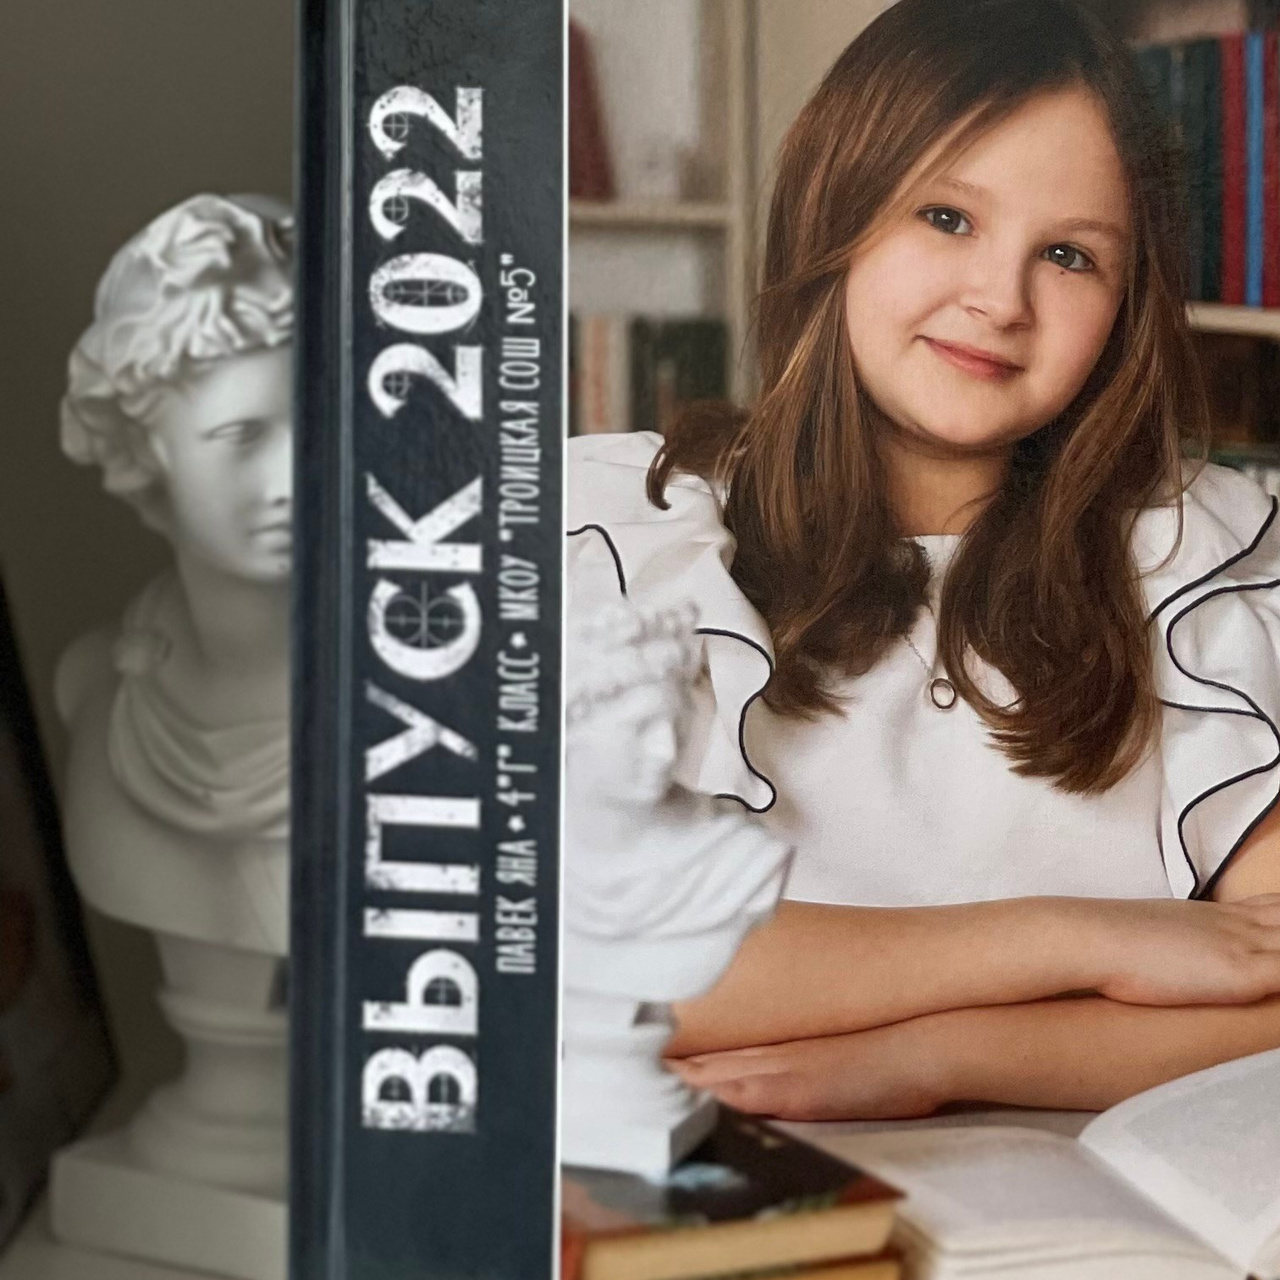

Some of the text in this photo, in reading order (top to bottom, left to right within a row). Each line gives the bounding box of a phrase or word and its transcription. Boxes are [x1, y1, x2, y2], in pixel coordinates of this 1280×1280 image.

[500, 253, 537, 325] №5"
[499, 337, 541, 391] СОШ
[498, 402, 541, 542] "ТРОИЦКАЯ
[361, 84, 484, 1134] ВЫПУСК 2022
[498, 555, 540, 621] МКОУ
[497, 651, 539, 732] КЛАСС
[496, 839, 537, 887] ЯНА
[496, 896, 537, 974] ПАВЕК
